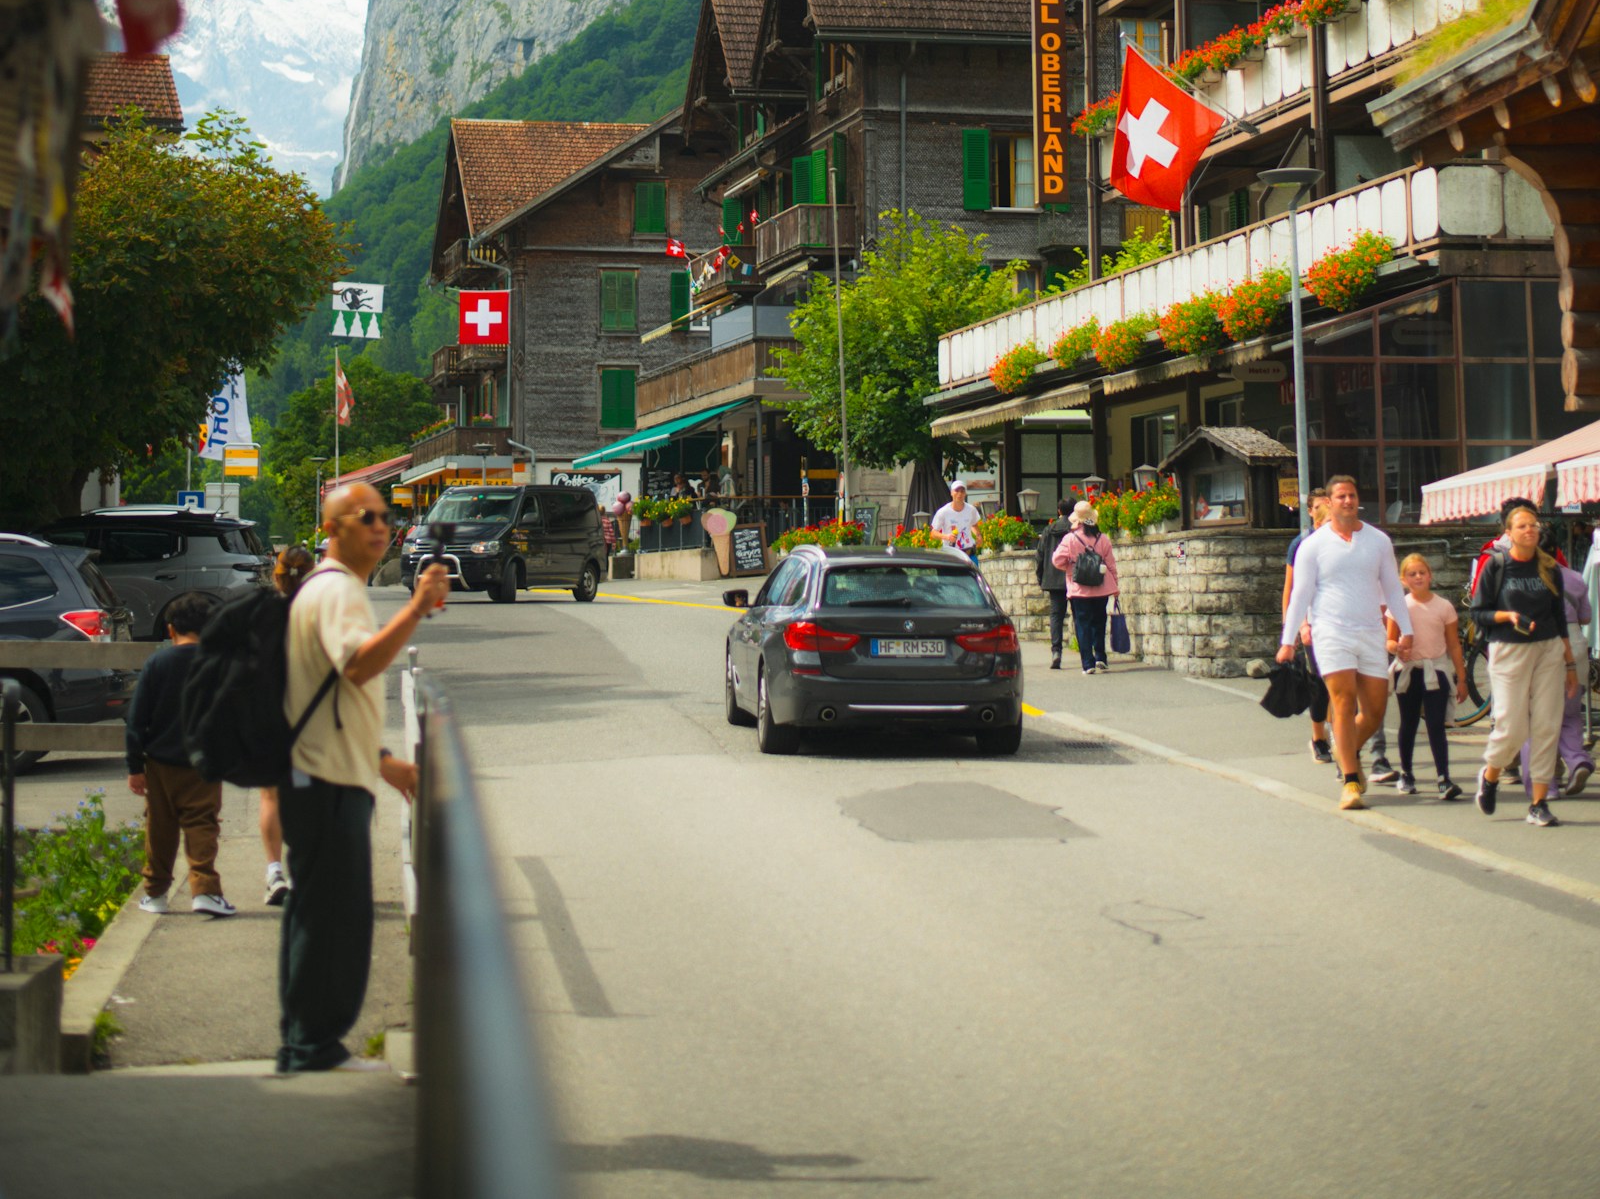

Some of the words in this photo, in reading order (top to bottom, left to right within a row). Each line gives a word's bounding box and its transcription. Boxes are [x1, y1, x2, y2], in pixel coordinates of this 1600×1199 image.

[1040, 32, 1064, 194] OBERLAND
[1507, 577, 1525, 591] NEW
[1525, 577, 1548, 591] YOR
[880, 642, 895, 653] HF
[903, 642, 919, 653] RM
[921, 642, 944, 653] 530
